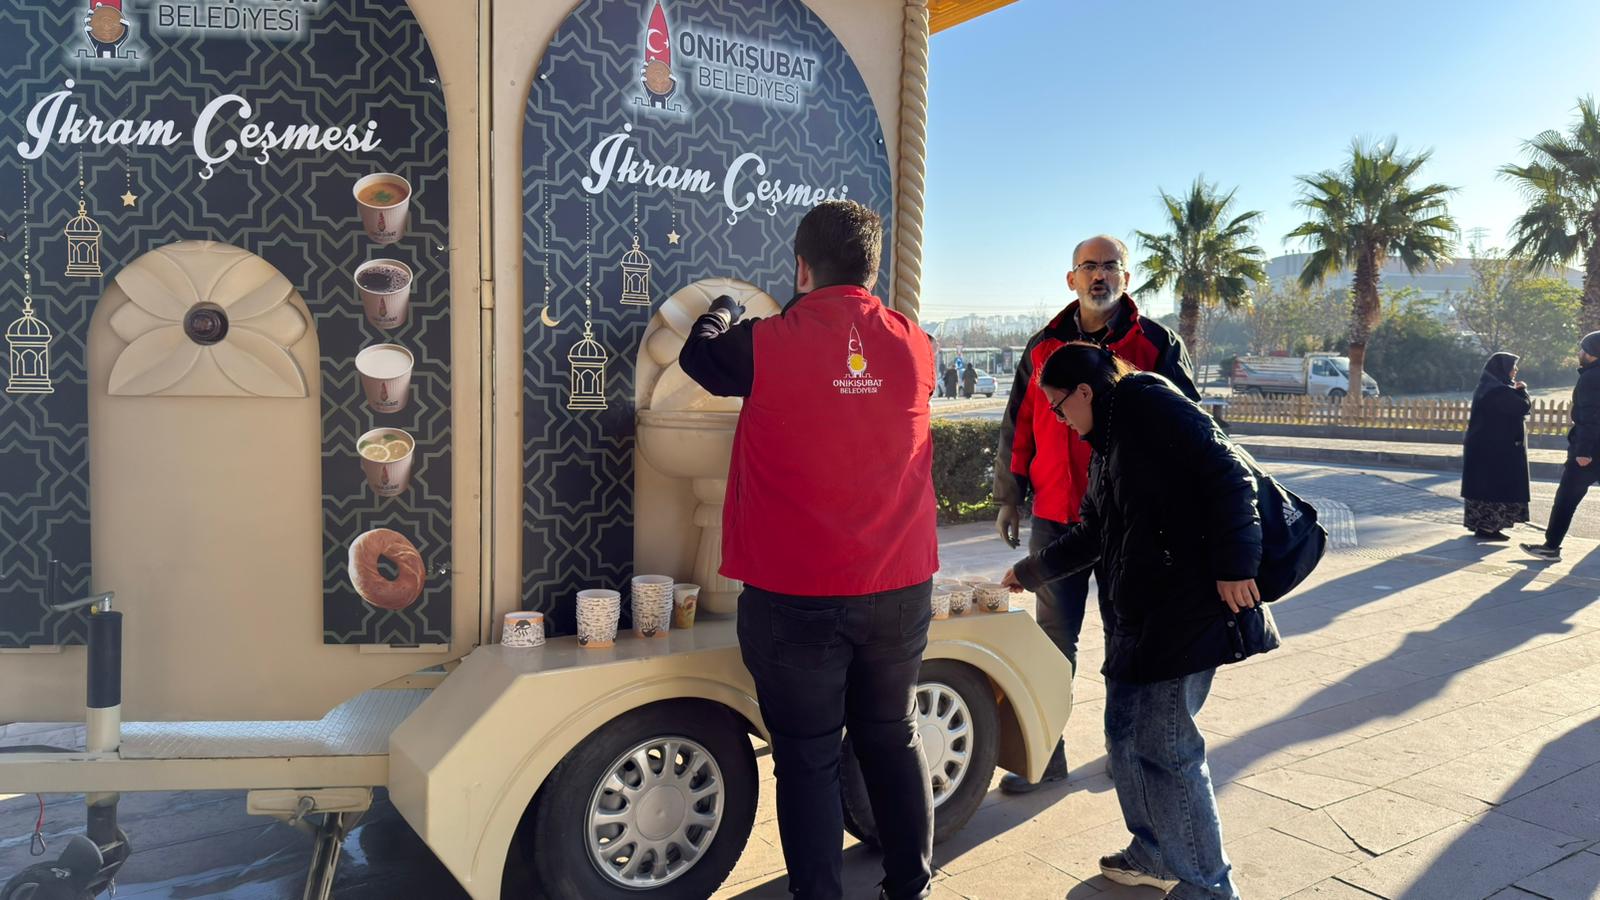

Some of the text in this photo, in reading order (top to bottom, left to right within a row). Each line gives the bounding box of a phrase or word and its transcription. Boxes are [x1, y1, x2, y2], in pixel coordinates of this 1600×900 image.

[17, 78, 382, 180] İkram Çeşmesi
[581, 122, 716, 195] İkram
